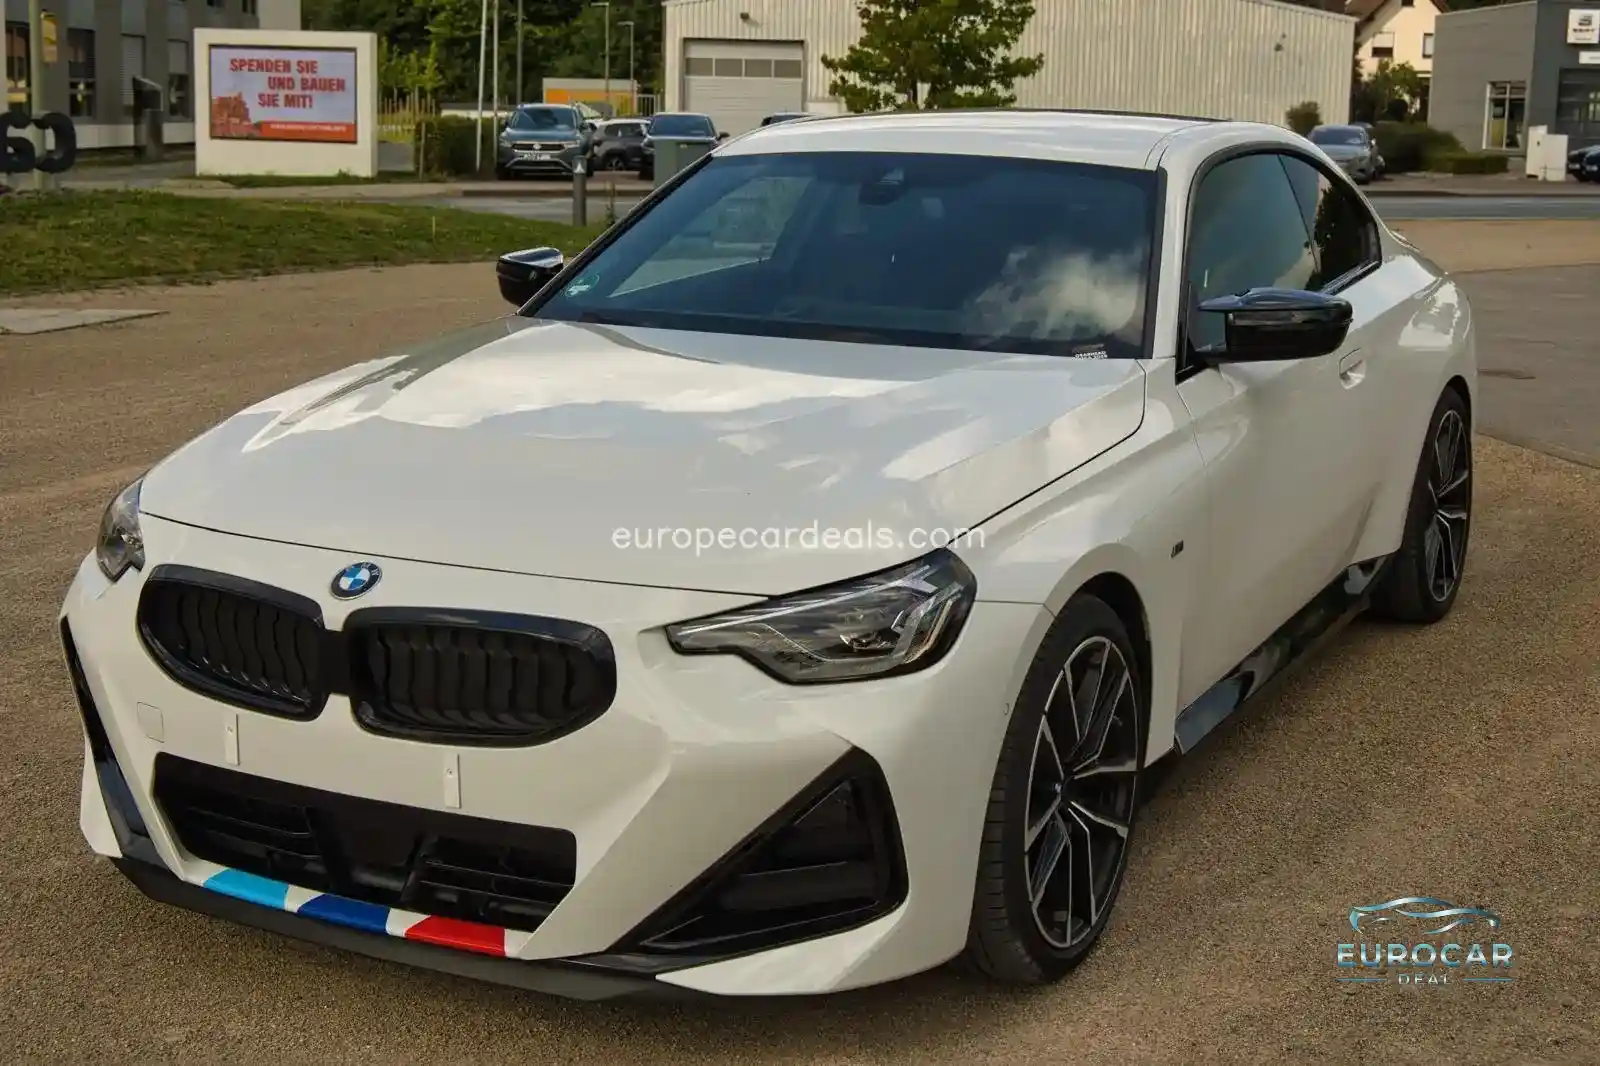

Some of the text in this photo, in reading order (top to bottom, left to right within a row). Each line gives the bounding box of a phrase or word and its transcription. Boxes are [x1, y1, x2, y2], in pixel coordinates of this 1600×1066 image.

[230, 58, 318, 74] SPENDEN SIE
[267, 76, 345, 92] UND BAUEN
[258, 93, 313, 108] SIE MIT!
